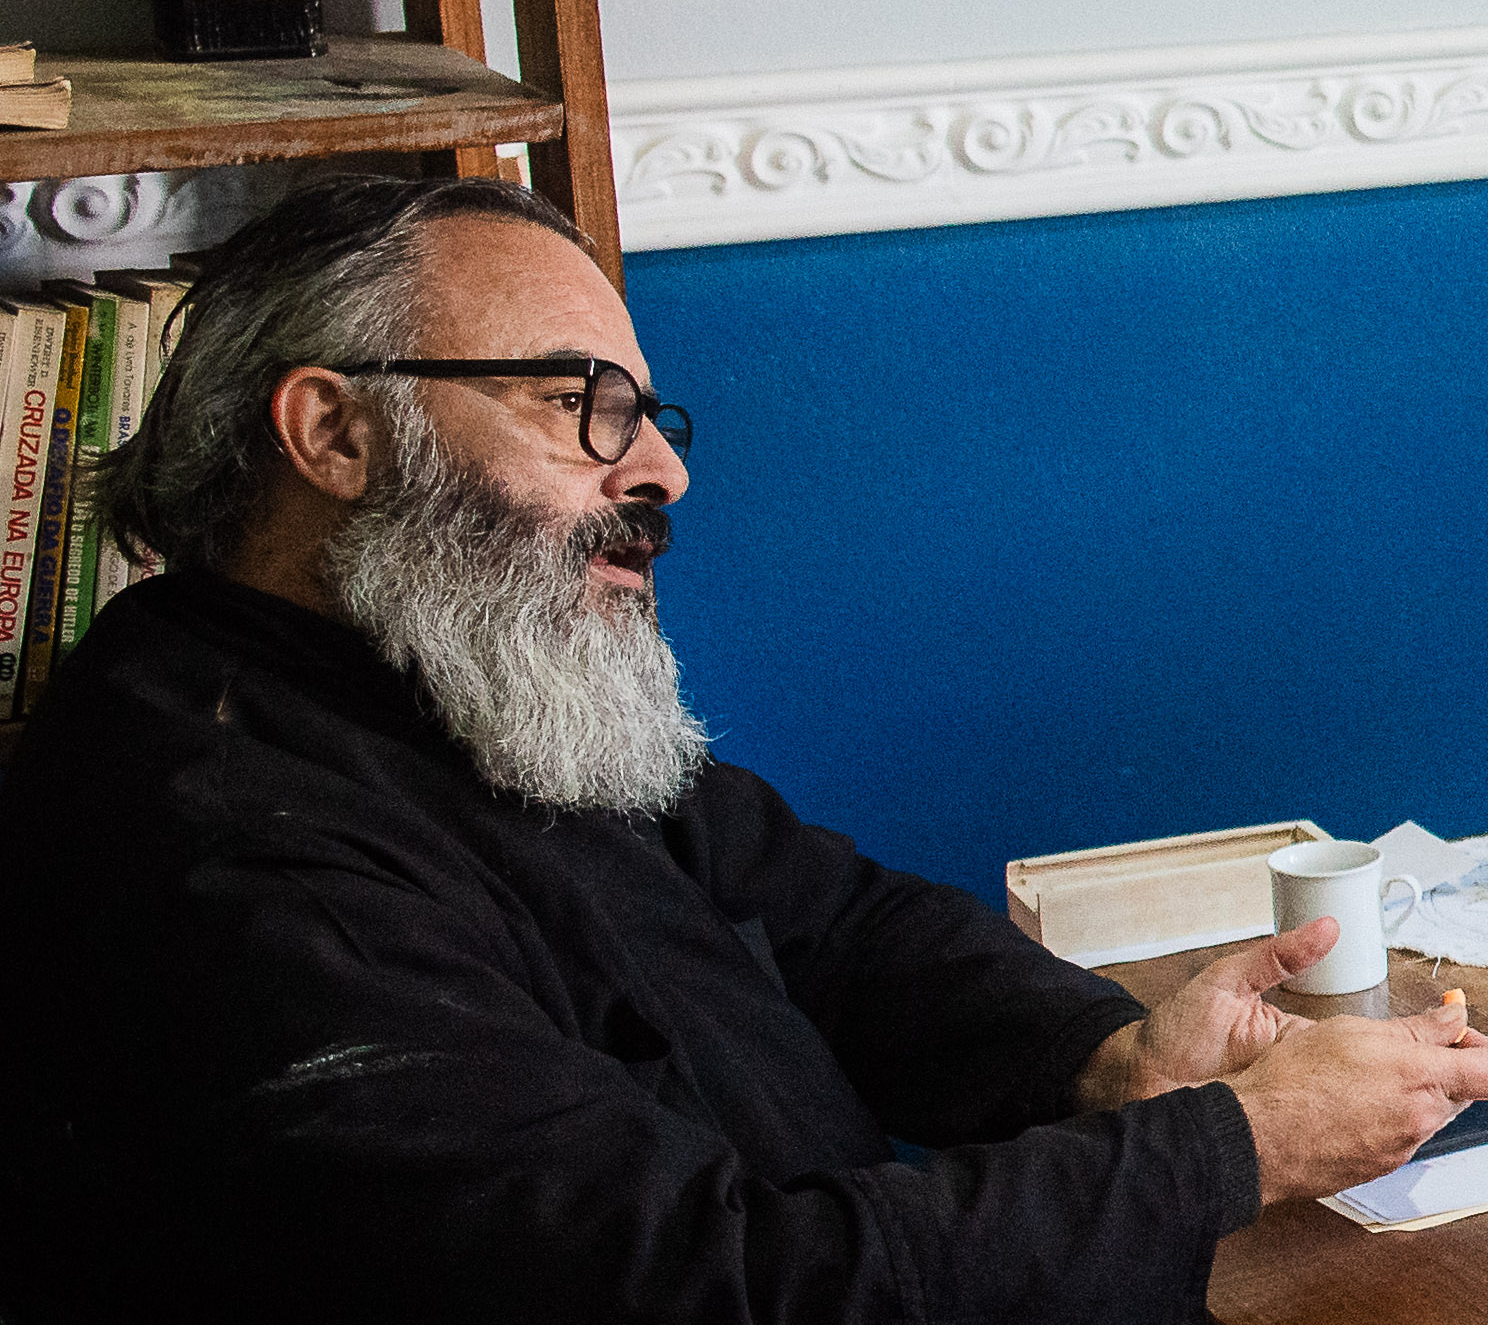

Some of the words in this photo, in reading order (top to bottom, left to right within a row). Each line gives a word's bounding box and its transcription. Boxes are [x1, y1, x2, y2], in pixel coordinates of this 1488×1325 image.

[54, 407, 72, 424] O
[12, 389, 46, 501] CRUZADA
[6, 509, 31, 543] NA
[41, 518, 63, 551] DA
[66, 534, 84, 585] SEGREDO
[0, 550, 26, 644] EUROPA
[33, 554, 58, 645] GUERRA
[65, 587, 79, 603] DE
[61, 605, 77, 643] HITLER
